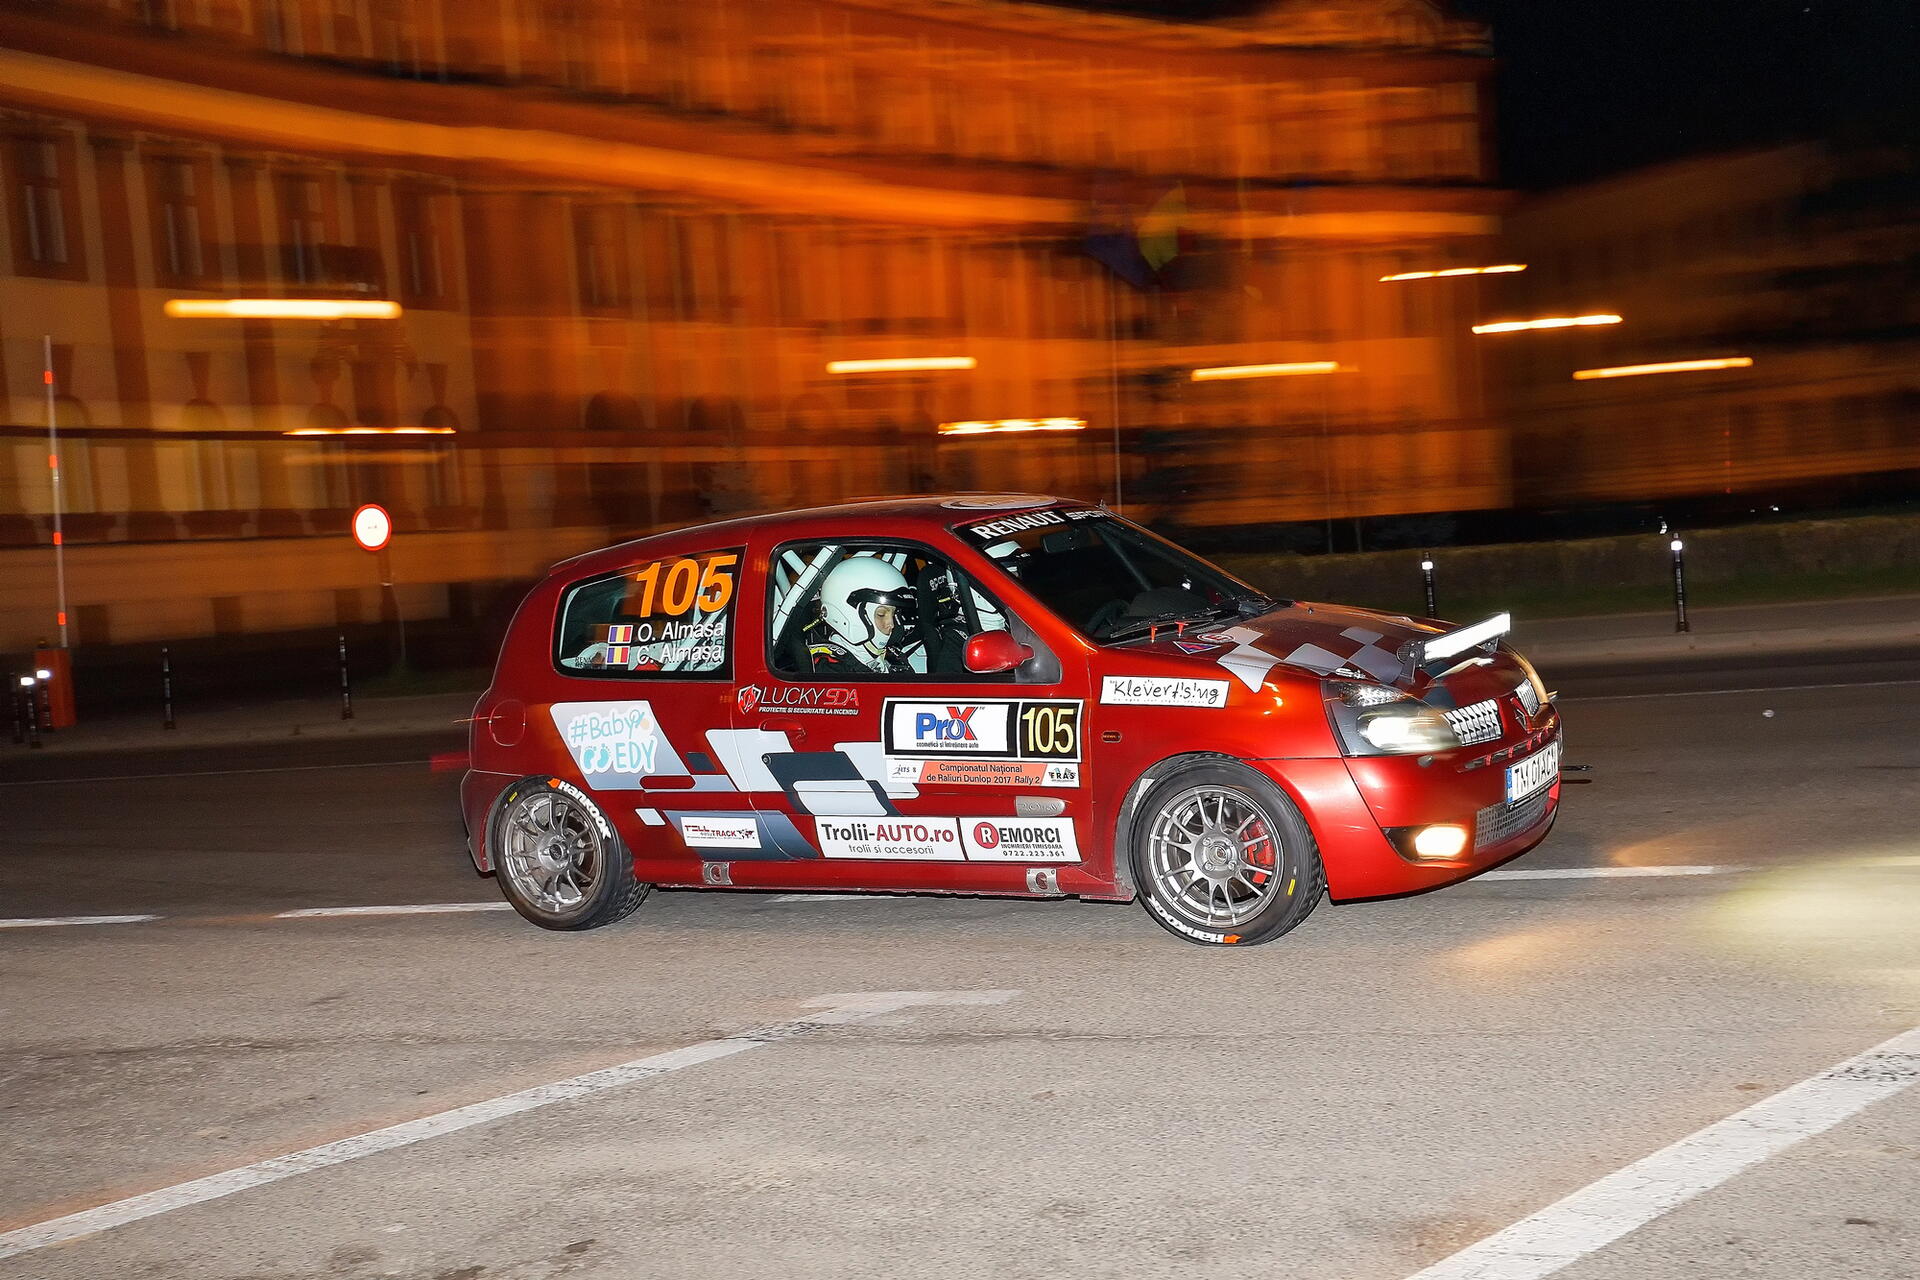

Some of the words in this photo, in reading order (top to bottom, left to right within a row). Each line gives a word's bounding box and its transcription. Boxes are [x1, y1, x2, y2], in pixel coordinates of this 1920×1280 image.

[970, 511, 1065, 539] RENAULT
[636, 554, 737, 618] 105
[637, 623, 656, 642] O.
[915, 706, 978, 740] ProX
[1021, 707, 1075, 753] 105
[616, 740, 654, 770] EDY
[938, 774, 961, 782] Raliuri
[964, 775, 991, 784] Dunlop
[1014, 776, 1033, 785] Rally
[939, 763, 988, 773] Campionatul
[557, 780, 611, 840] Hankook
[821, 823, 954, 843] Trolii-AUTO.ro
[980, 827, 1061, 843] REMORCI
[849, 844, 871, 854] trolii
[874, 844, 882, 854] si
[884, 845, 934, 854] accesorii
